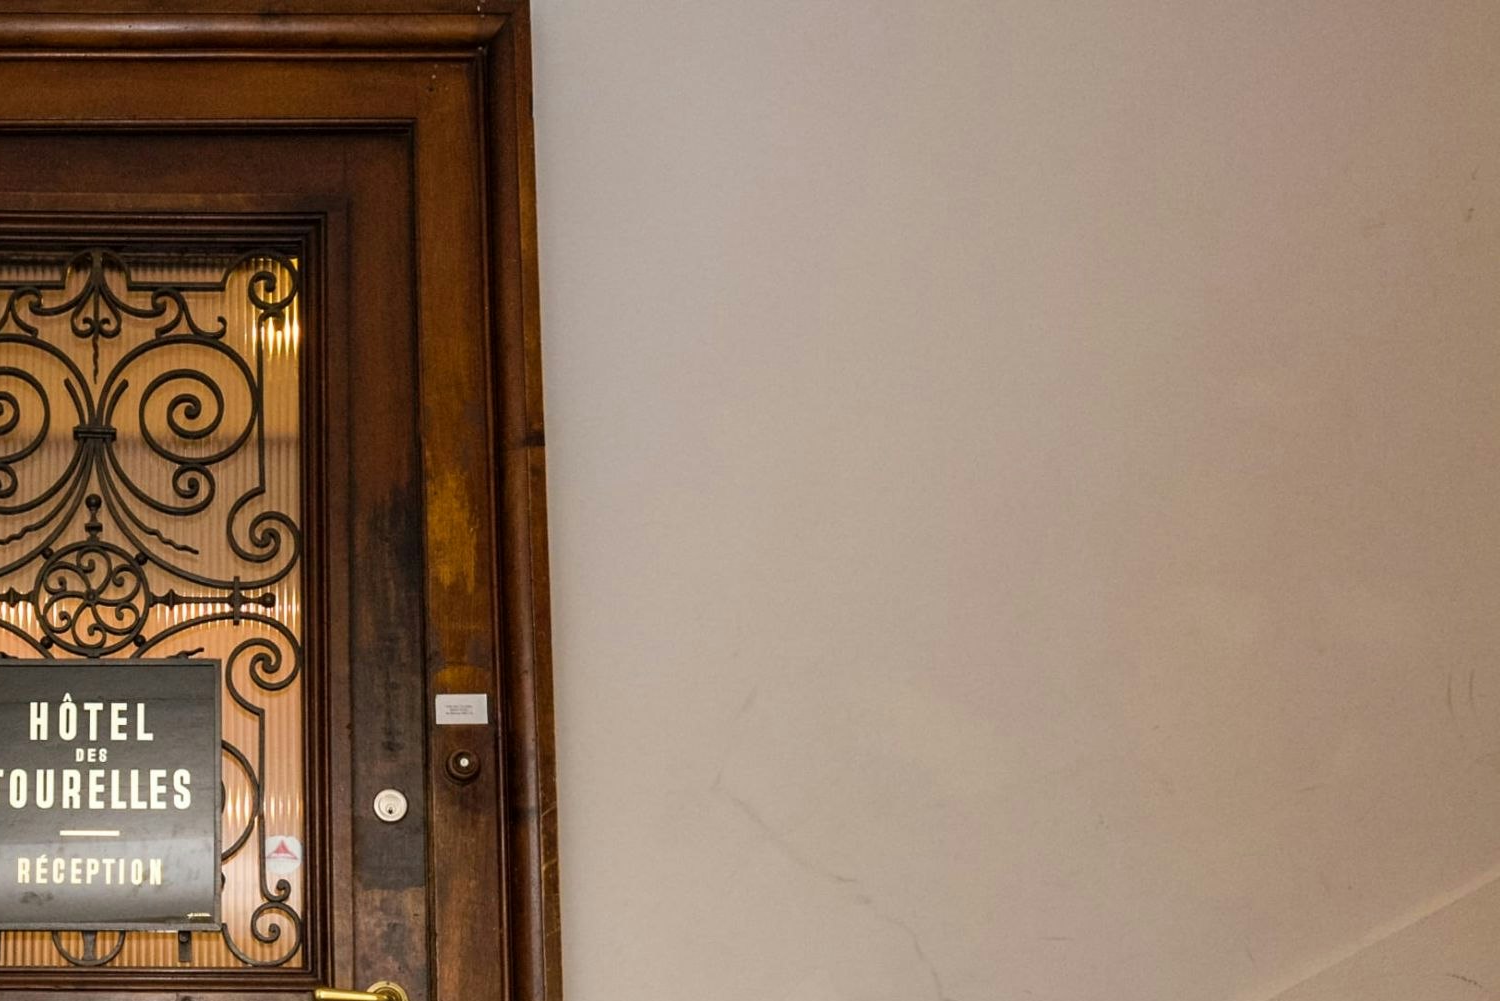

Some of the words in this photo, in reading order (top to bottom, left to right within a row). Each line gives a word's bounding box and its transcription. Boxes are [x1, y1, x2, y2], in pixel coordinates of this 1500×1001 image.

[29, 693, 154, 741] HÔTEL
[75, 748, 108, 762] DES
[17, 854, 162, 886] RÉCEPTION
